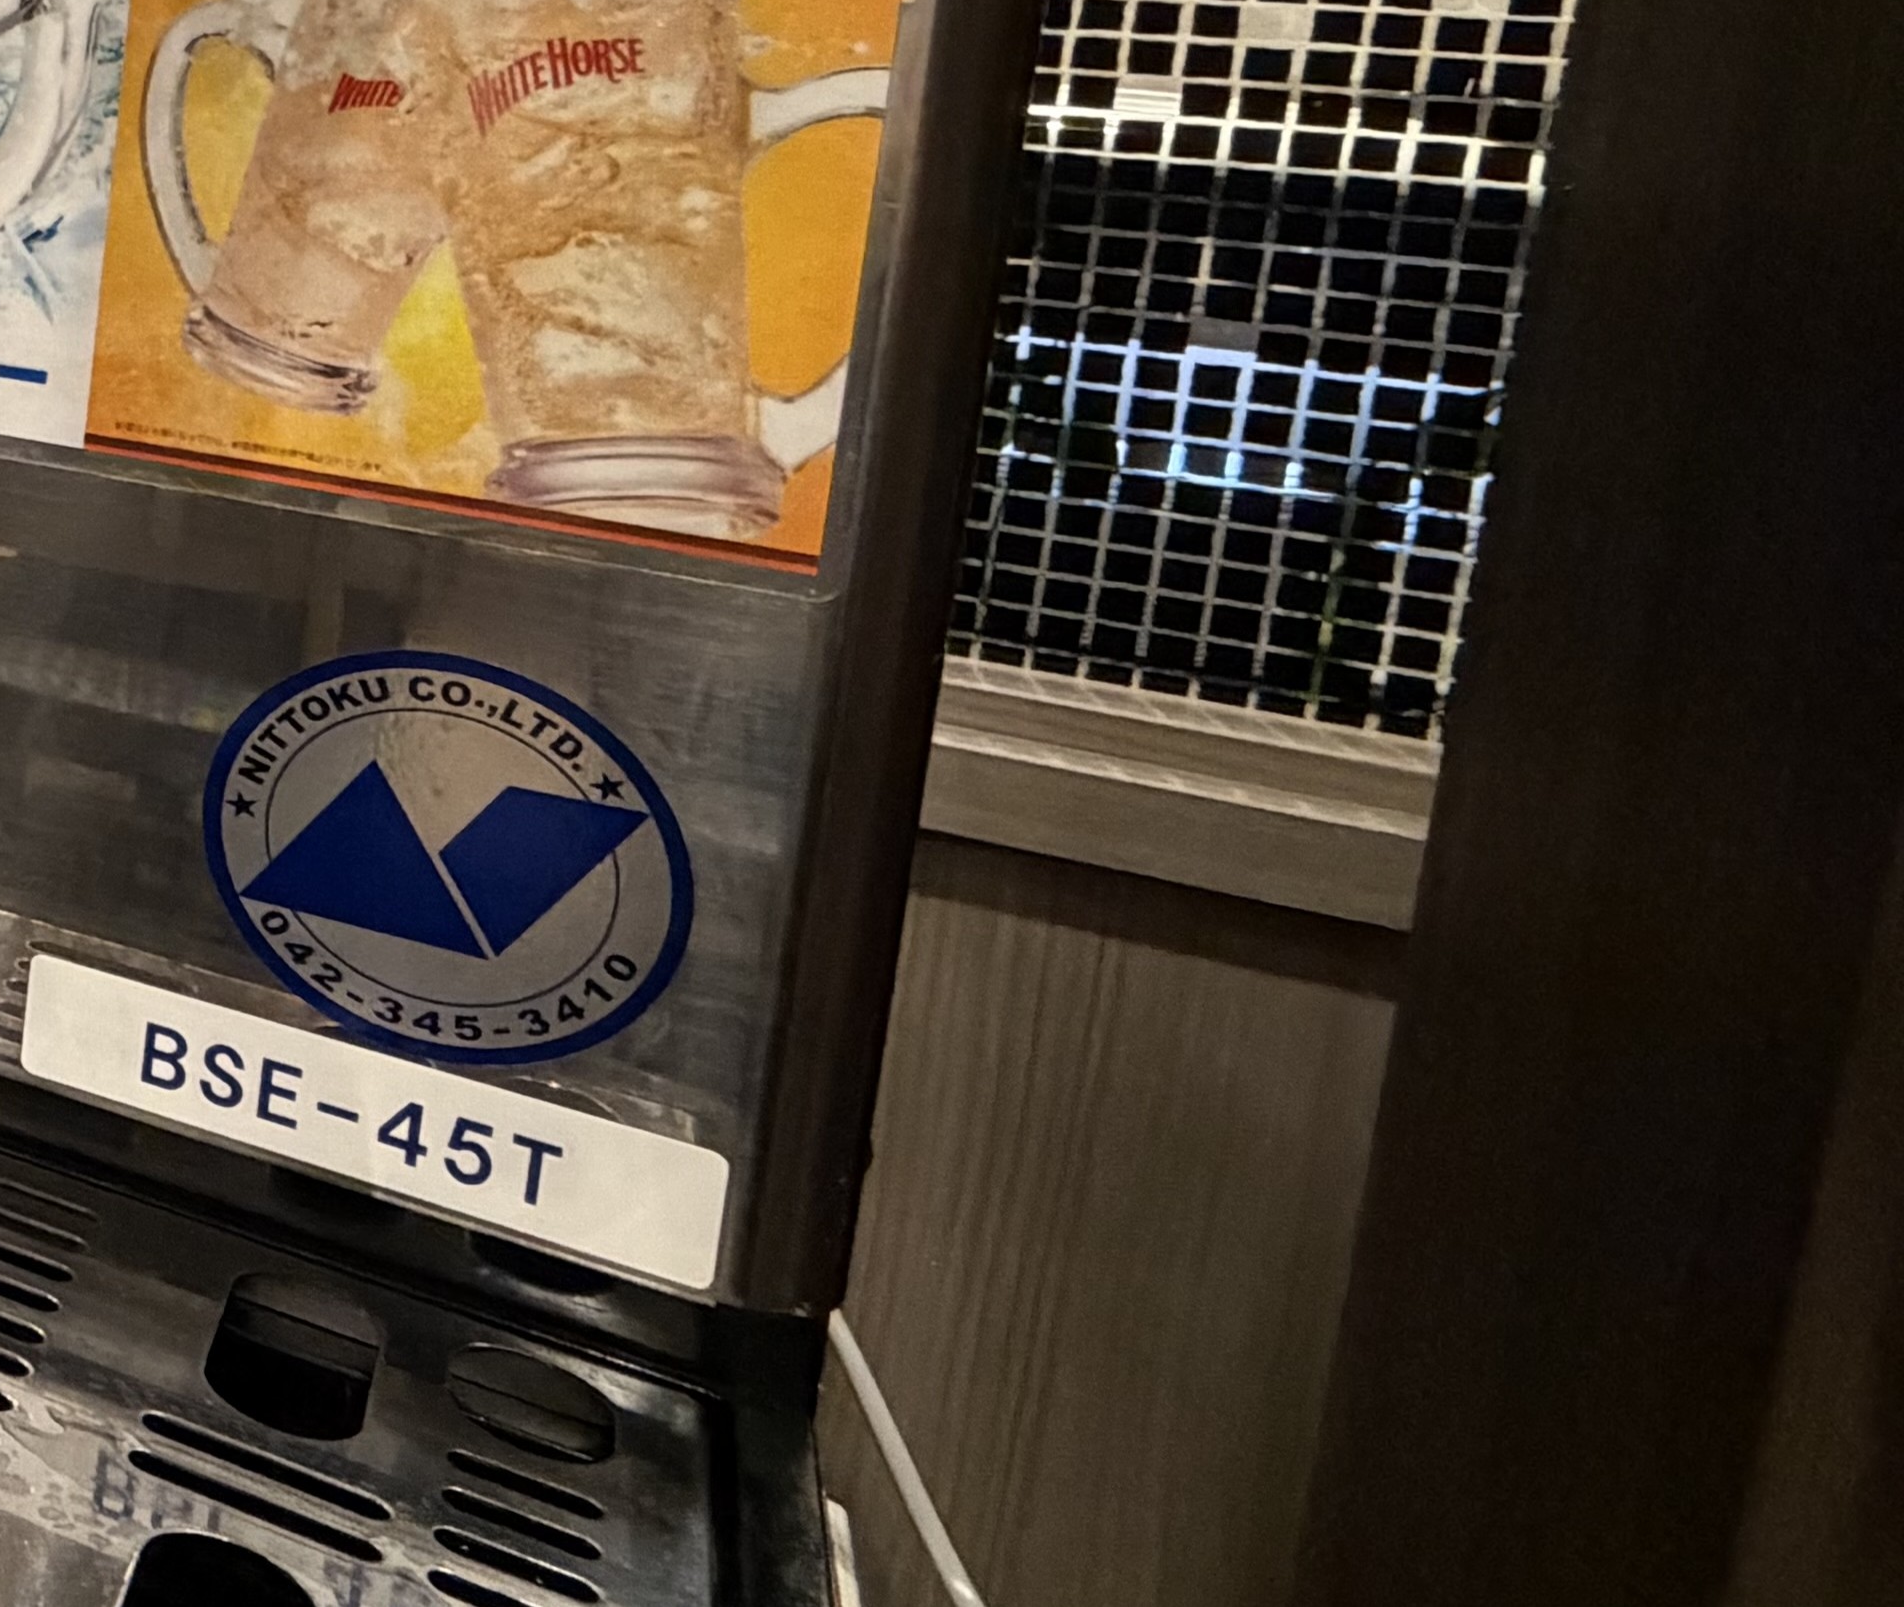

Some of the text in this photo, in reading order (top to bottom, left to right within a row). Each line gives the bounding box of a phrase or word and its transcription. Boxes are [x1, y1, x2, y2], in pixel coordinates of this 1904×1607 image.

[238, 676, 392, 786] NITTOKU
[259, 909, 639, 1043] 042-345-3410
[138, 1021, 564, 1207] BSE-45T
